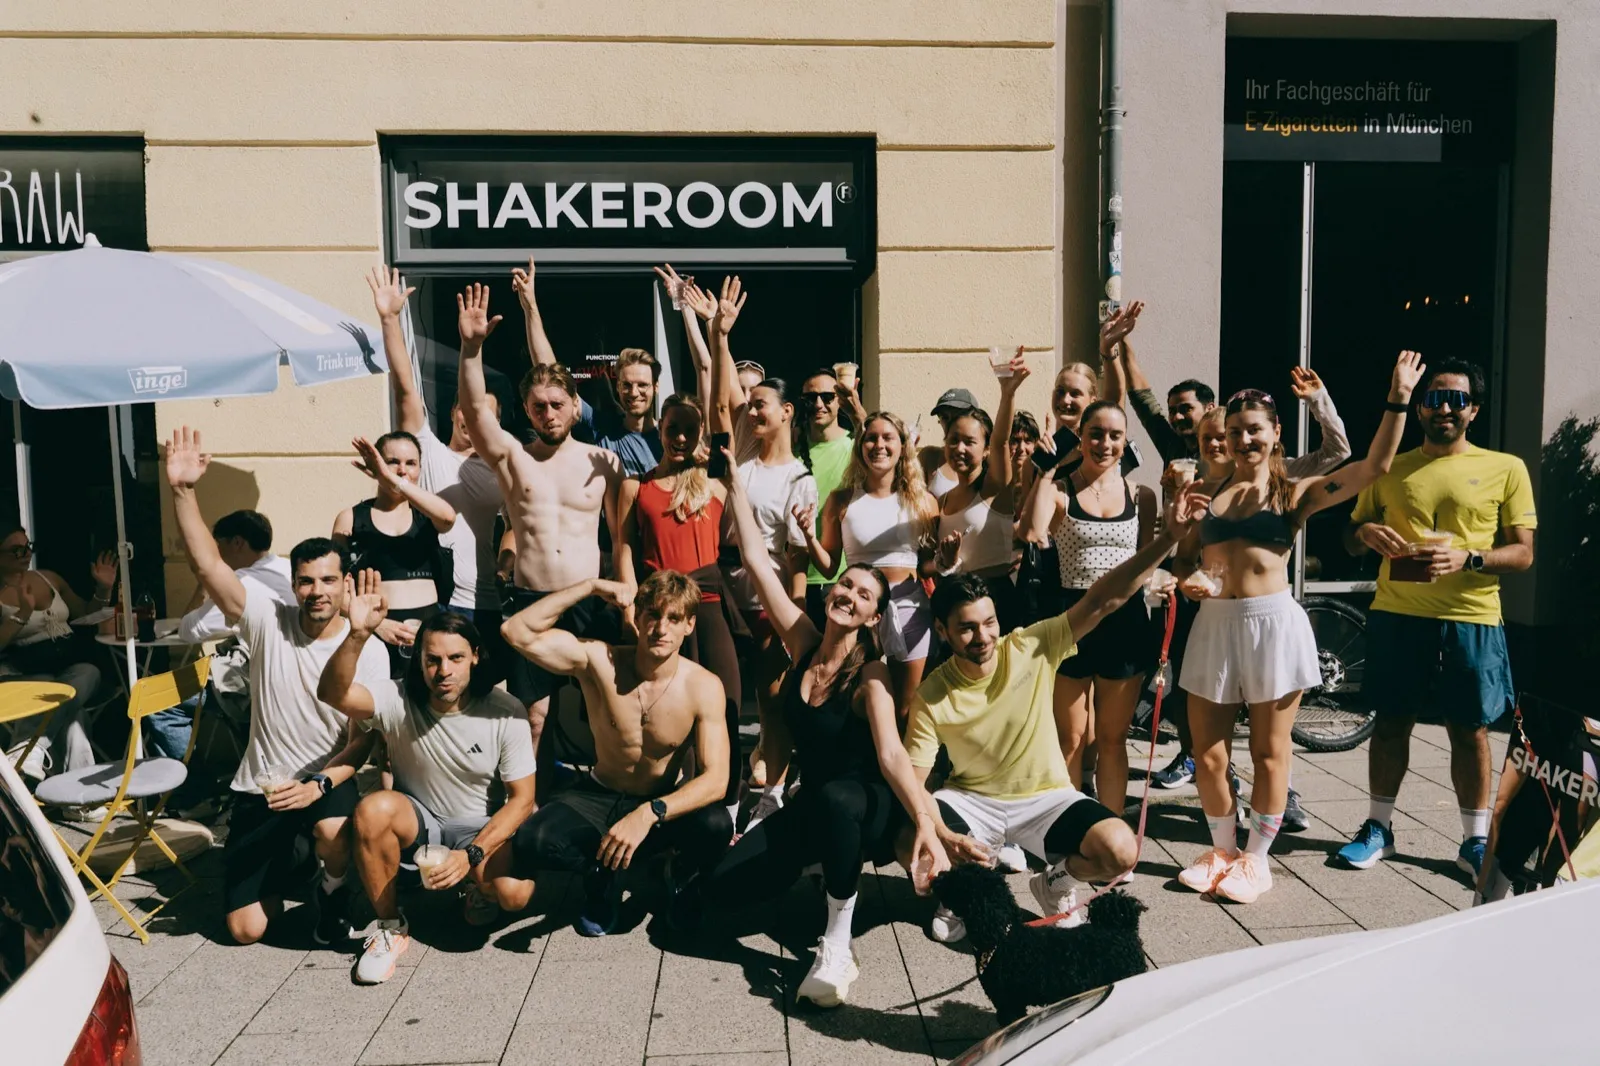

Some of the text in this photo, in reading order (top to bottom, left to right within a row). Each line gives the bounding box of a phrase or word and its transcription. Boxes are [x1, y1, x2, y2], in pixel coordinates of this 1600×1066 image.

[1245, 79, 1432, 105] Ihr Fachgeschäft für
[1245, 111, 1473, 137] E-Zigaretten in München
[316, 352, 344, 372] Trink
[135, 371, 182, 394] inge
[1511, 746, 1600, 808] SHAKER
